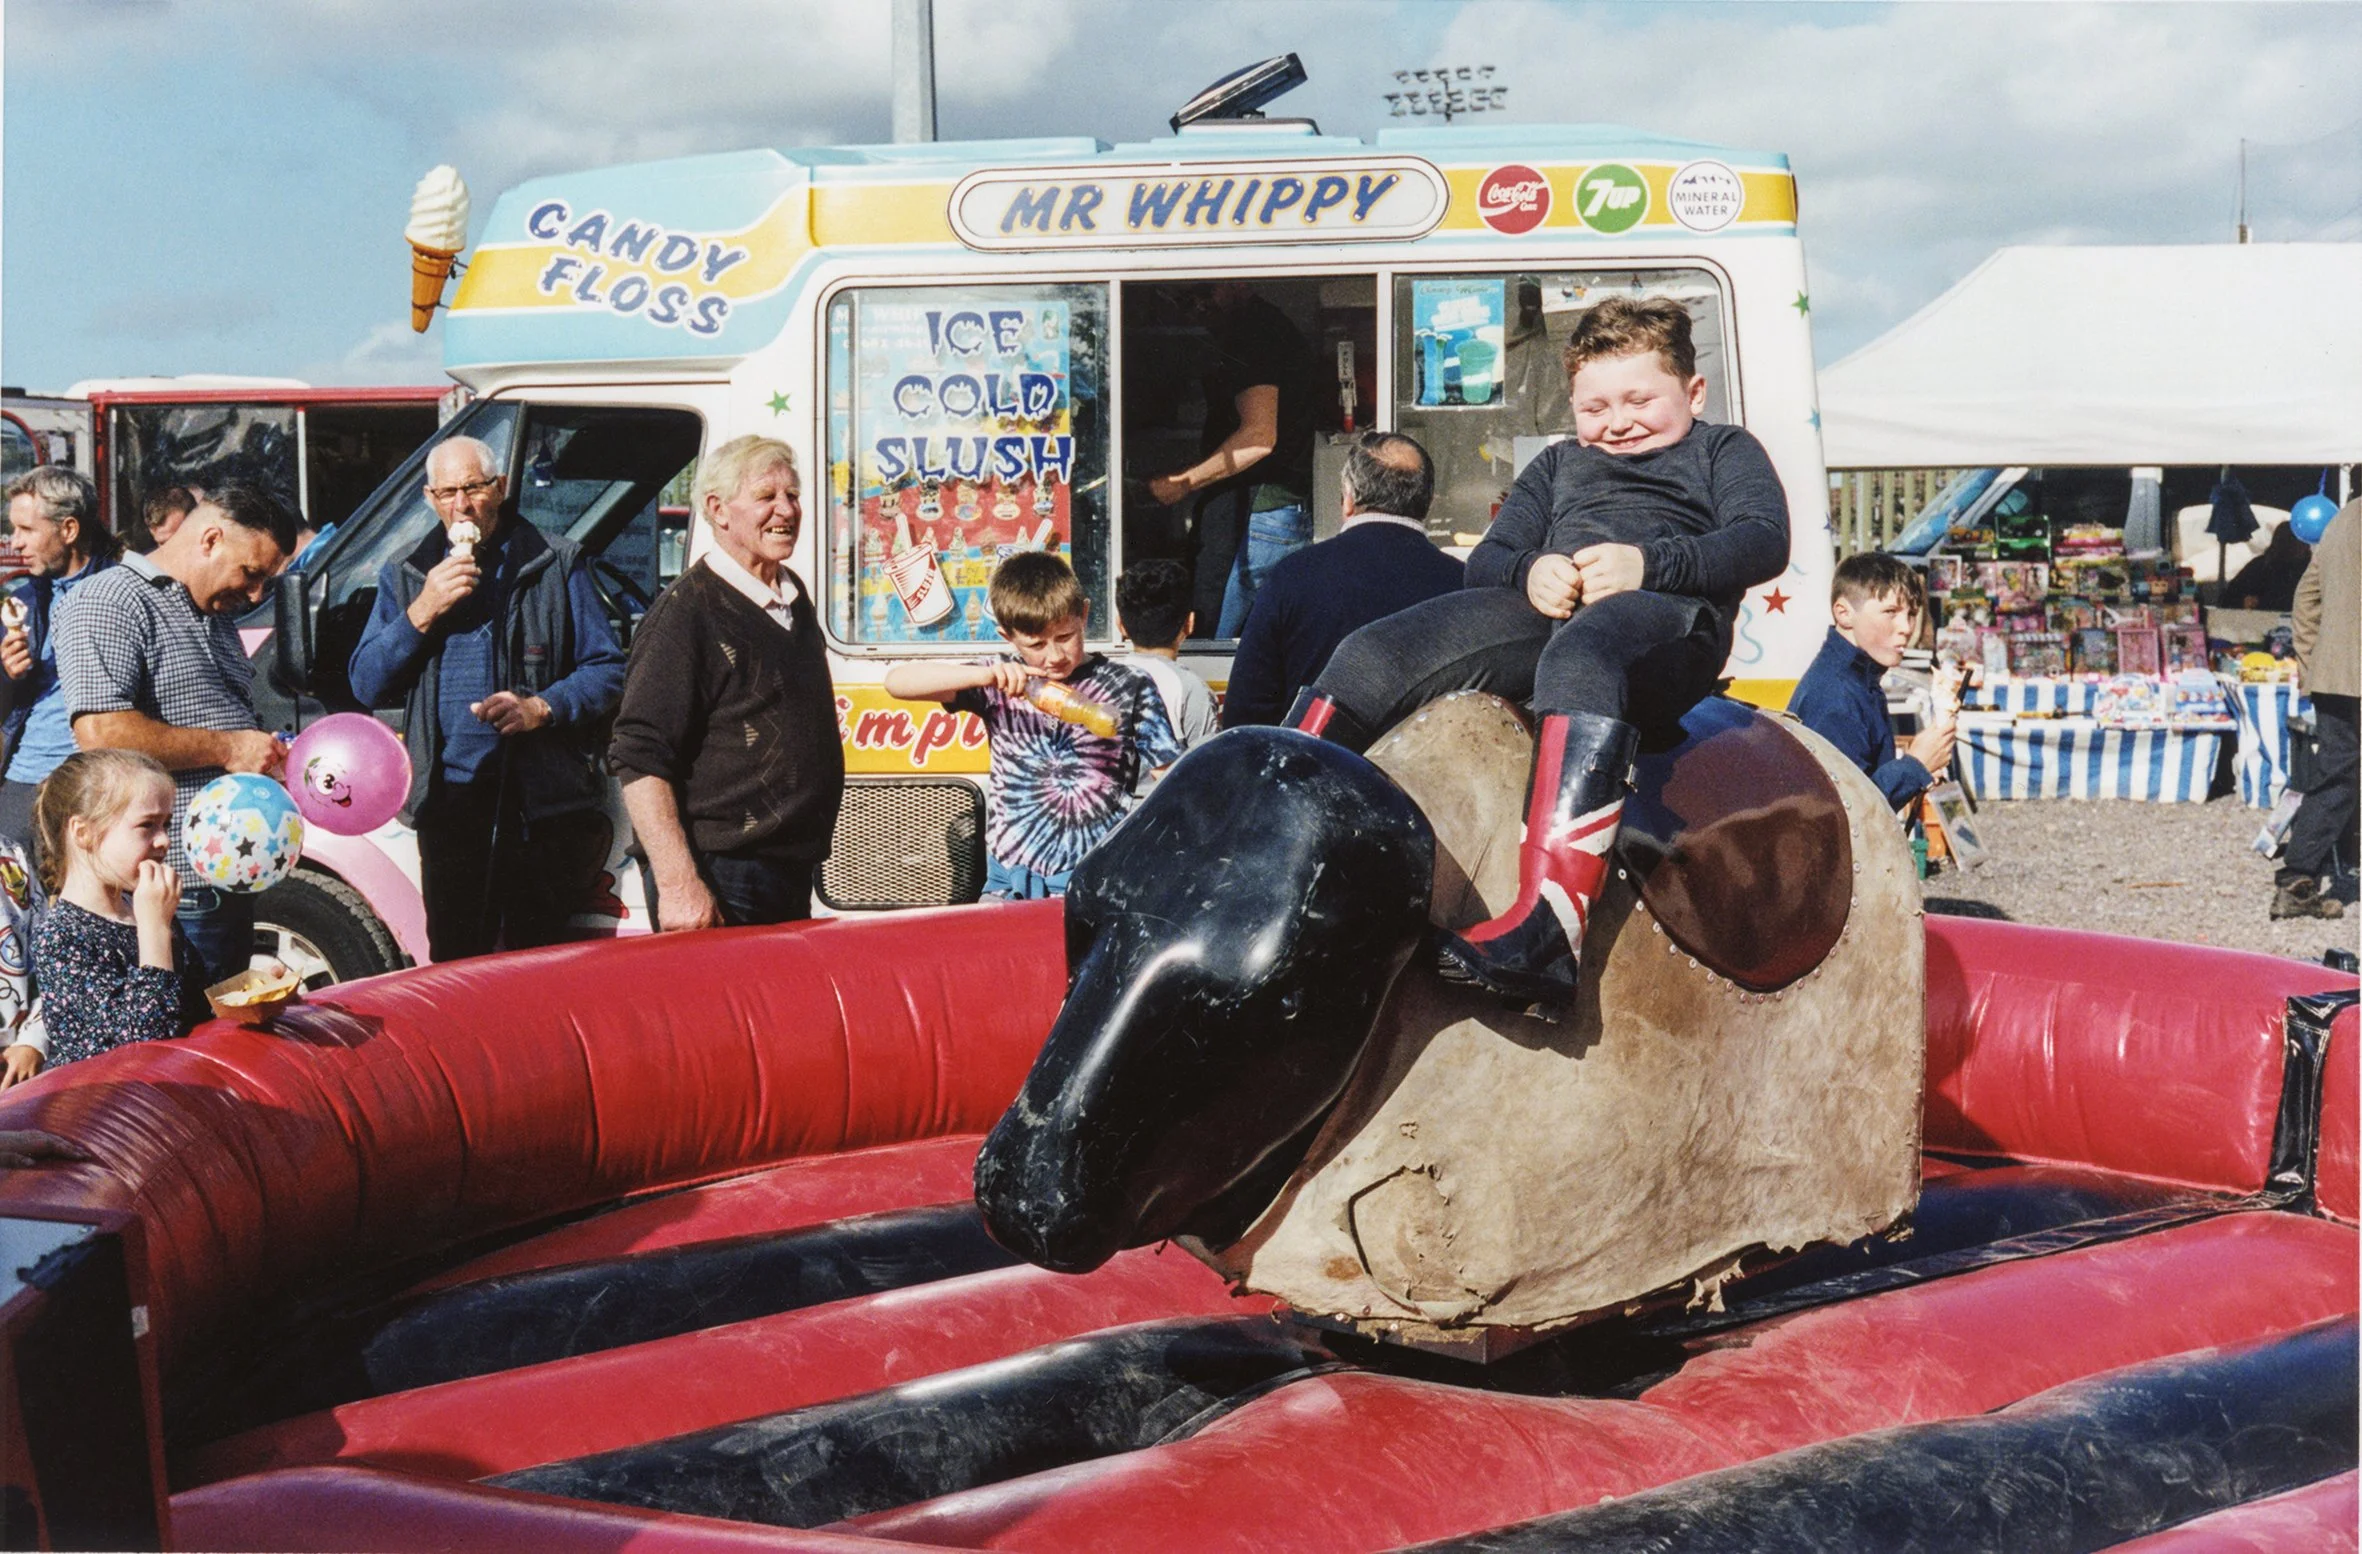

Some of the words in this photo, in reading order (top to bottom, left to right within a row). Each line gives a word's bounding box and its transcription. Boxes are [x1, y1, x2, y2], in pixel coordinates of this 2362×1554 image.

[1000, 184, 1103, 233] MR
[1128, 174, 1400, 228] WHIPPY
[1675, 191, 1737, 203] MINERAL
[1684, 205, 1728, 216] WATER
[528, 202, 746, 283] CANDY
[540, 256, 728, 334] FLOSS
[925, 310, 1025, 356] ICE
[893, 374, 1056, 419] COLD
[876, 436, 1074, 484] SLUSH
